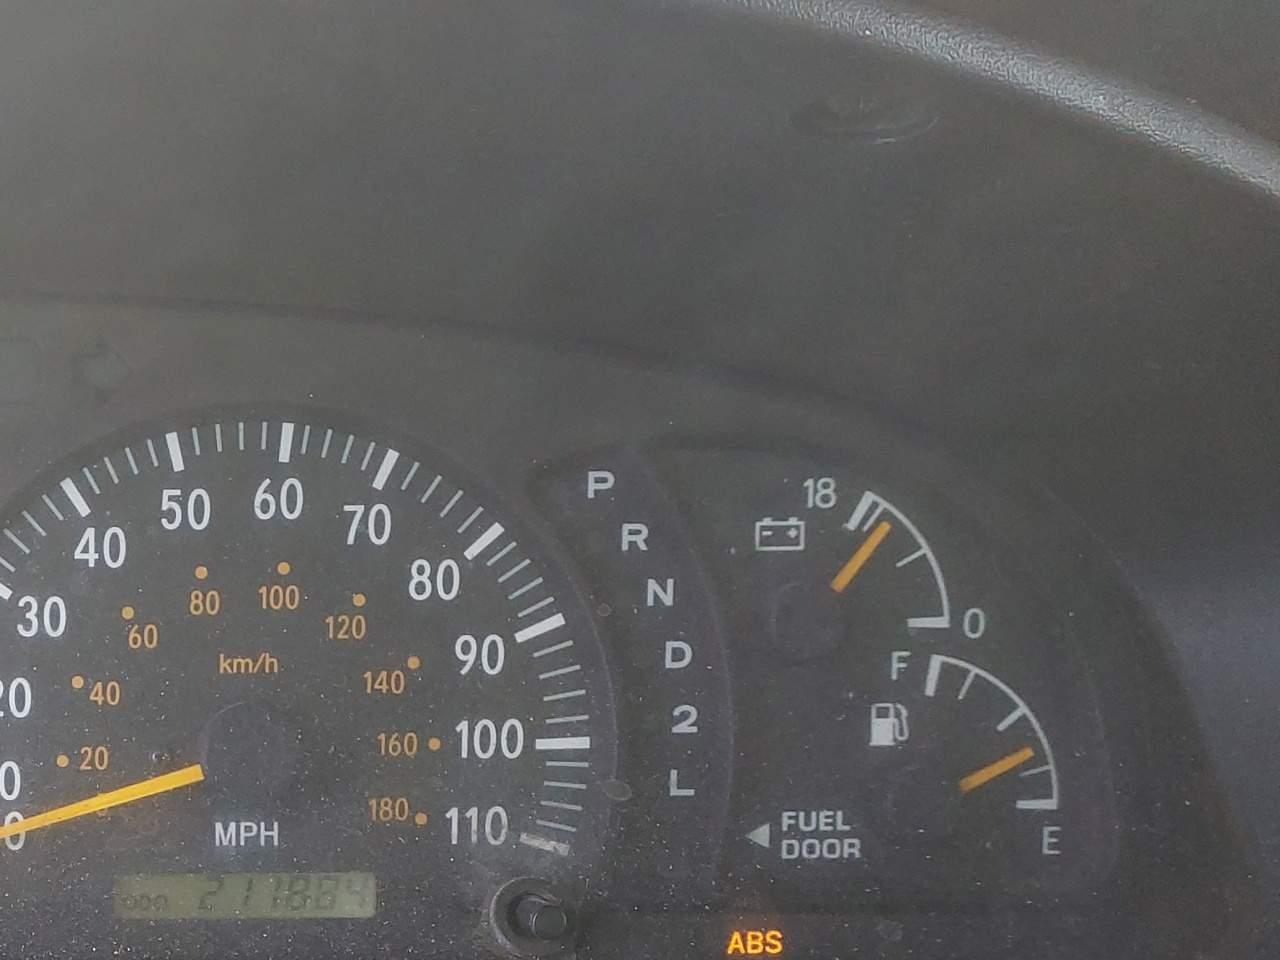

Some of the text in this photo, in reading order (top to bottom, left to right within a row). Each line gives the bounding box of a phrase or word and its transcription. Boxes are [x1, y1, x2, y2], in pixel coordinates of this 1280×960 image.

[254, 477, 304, 520] 60
[587, 470, 615, 499] P
[803, 477, 837, 509] 18
[161, 488, 211, 531] 50
[343, 503, 392, 546] 70
[621, 523, 649, 551] R
[74, 526, 126, 569] 40
[408, 558, 460, 601] 80
[647, 578, 674, 607] N
[190, 590, 220, 615] 80
[258, 585, 300, 610] 100
[17, 595, 67, 638] 30
[325, 615, 366, 639] 120
[963, 607, 985, 639] 0
[128, 624, 158, 649] 60
[219, 652, 278, 673] km/h
[455, 634, 505, 675] 90
[665, 640, 693, 669] D
[891, 651, 911, 681] F
[89, 681, 120, 705] 40
[363, 670, 405, 694] 140
[671, 704, 698, 733] 2
[377, 732, 418, 757] 160
[455, 718, 524, 759] 100
[79, 746, 109, 770] 20
[669, 769, 695, 797] L
[368, 797, 409, 821] 180
[782, 810, 851, 832] FUEL
[3, 811, 26, 852] 0
[215, 821, 279, 847] MPH
[445, 805, 508, 846] 110
[781, 838, 860, 859] DOOR
[1042, 826, 1061, 855] E
[728, 931, 782, 954] ABS
